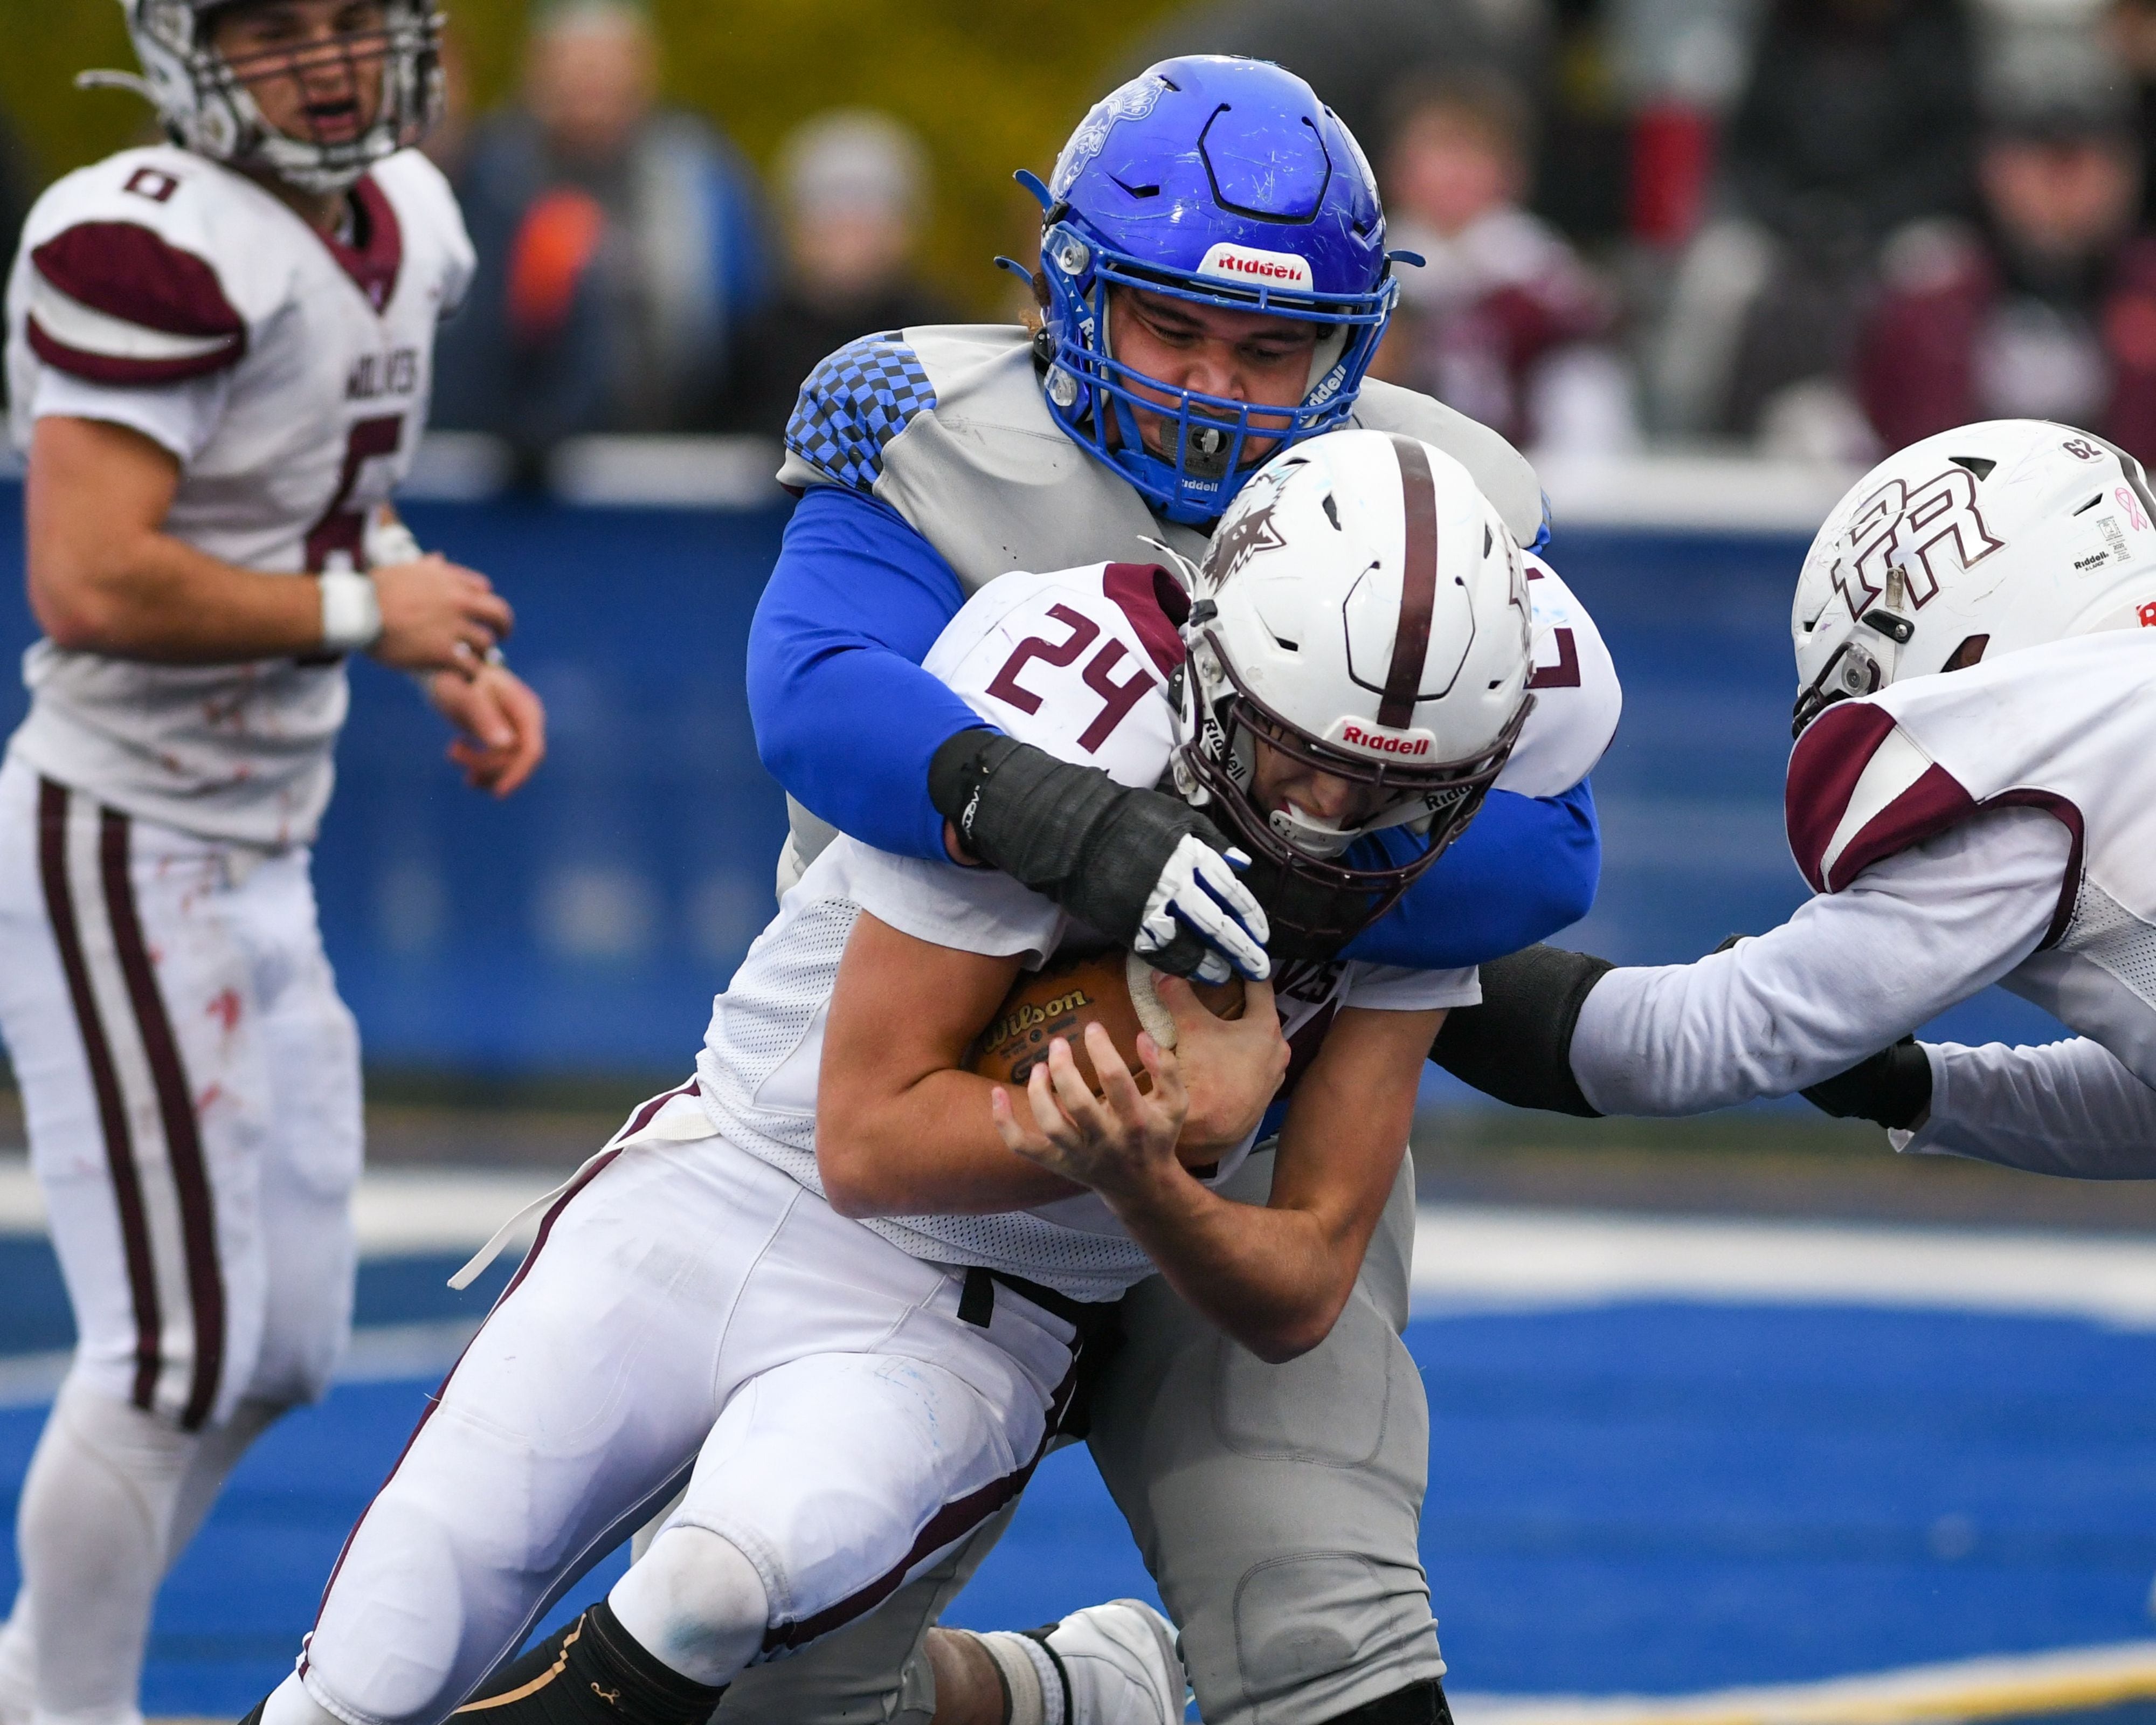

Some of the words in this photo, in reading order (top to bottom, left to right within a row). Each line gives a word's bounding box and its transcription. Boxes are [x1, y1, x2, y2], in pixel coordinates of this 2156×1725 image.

[1218, 252, 1303, 281] Riddell
[1298, 364, 1346, 424] ddell
[2062, 438, 2103, 460] 62
[1181, 478, 1219, 493] iddell
[2074, 551, 2107, 570] Riddell
[984, 603, 1158, 755] 24
[1203, 717, 1247, 781] Ridell
[1343, 726, 1429, 755] Riddell
[983, 989, 1088, 1052] Wilson
